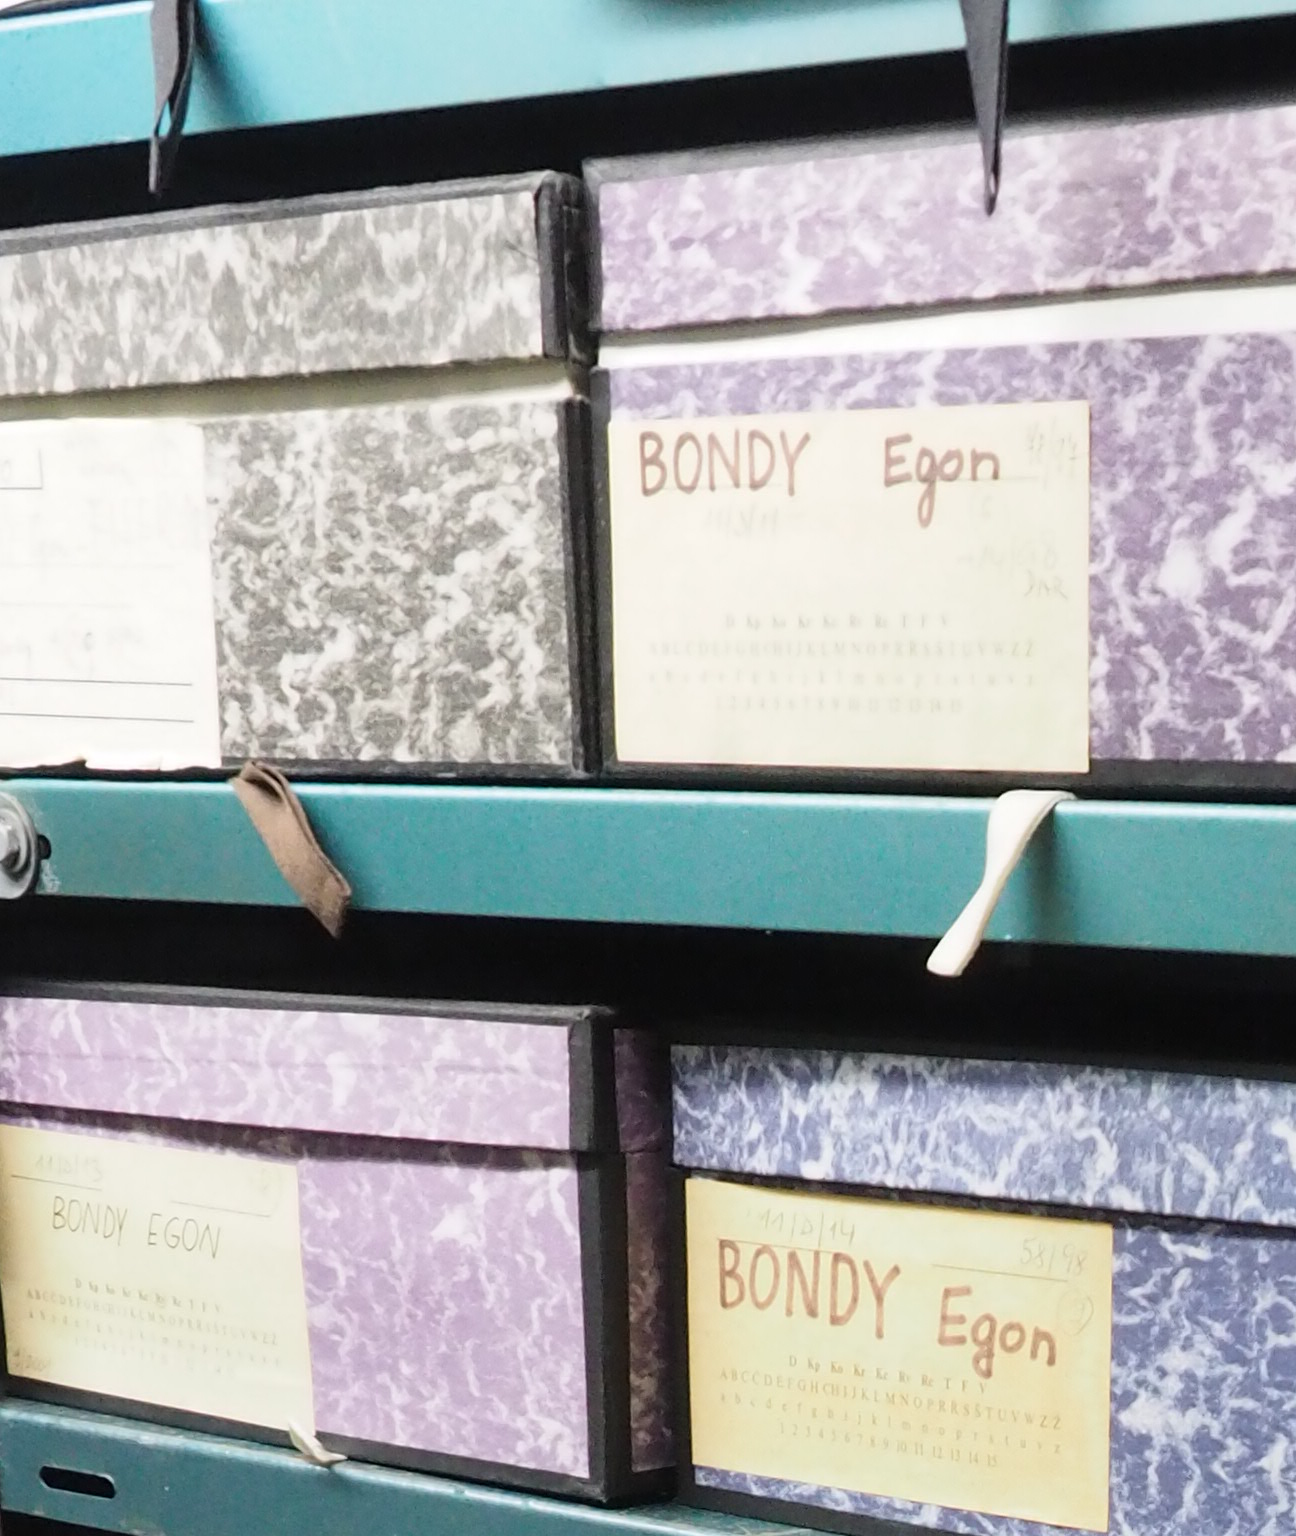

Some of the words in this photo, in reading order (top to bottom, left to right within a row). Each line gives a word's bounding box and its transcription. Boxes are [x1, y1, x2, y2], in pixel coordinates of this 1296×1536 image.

[638, 428, 811, 497] BONDY
[884, 434, 1001, 528] Egon
[52, 1196, 127, 1246] BONDY
[148, 1213, 220, 1258] EGON
[719, 1239, 901, 1340] BONDY
[938, 1286, 1057, 1379] Egon
